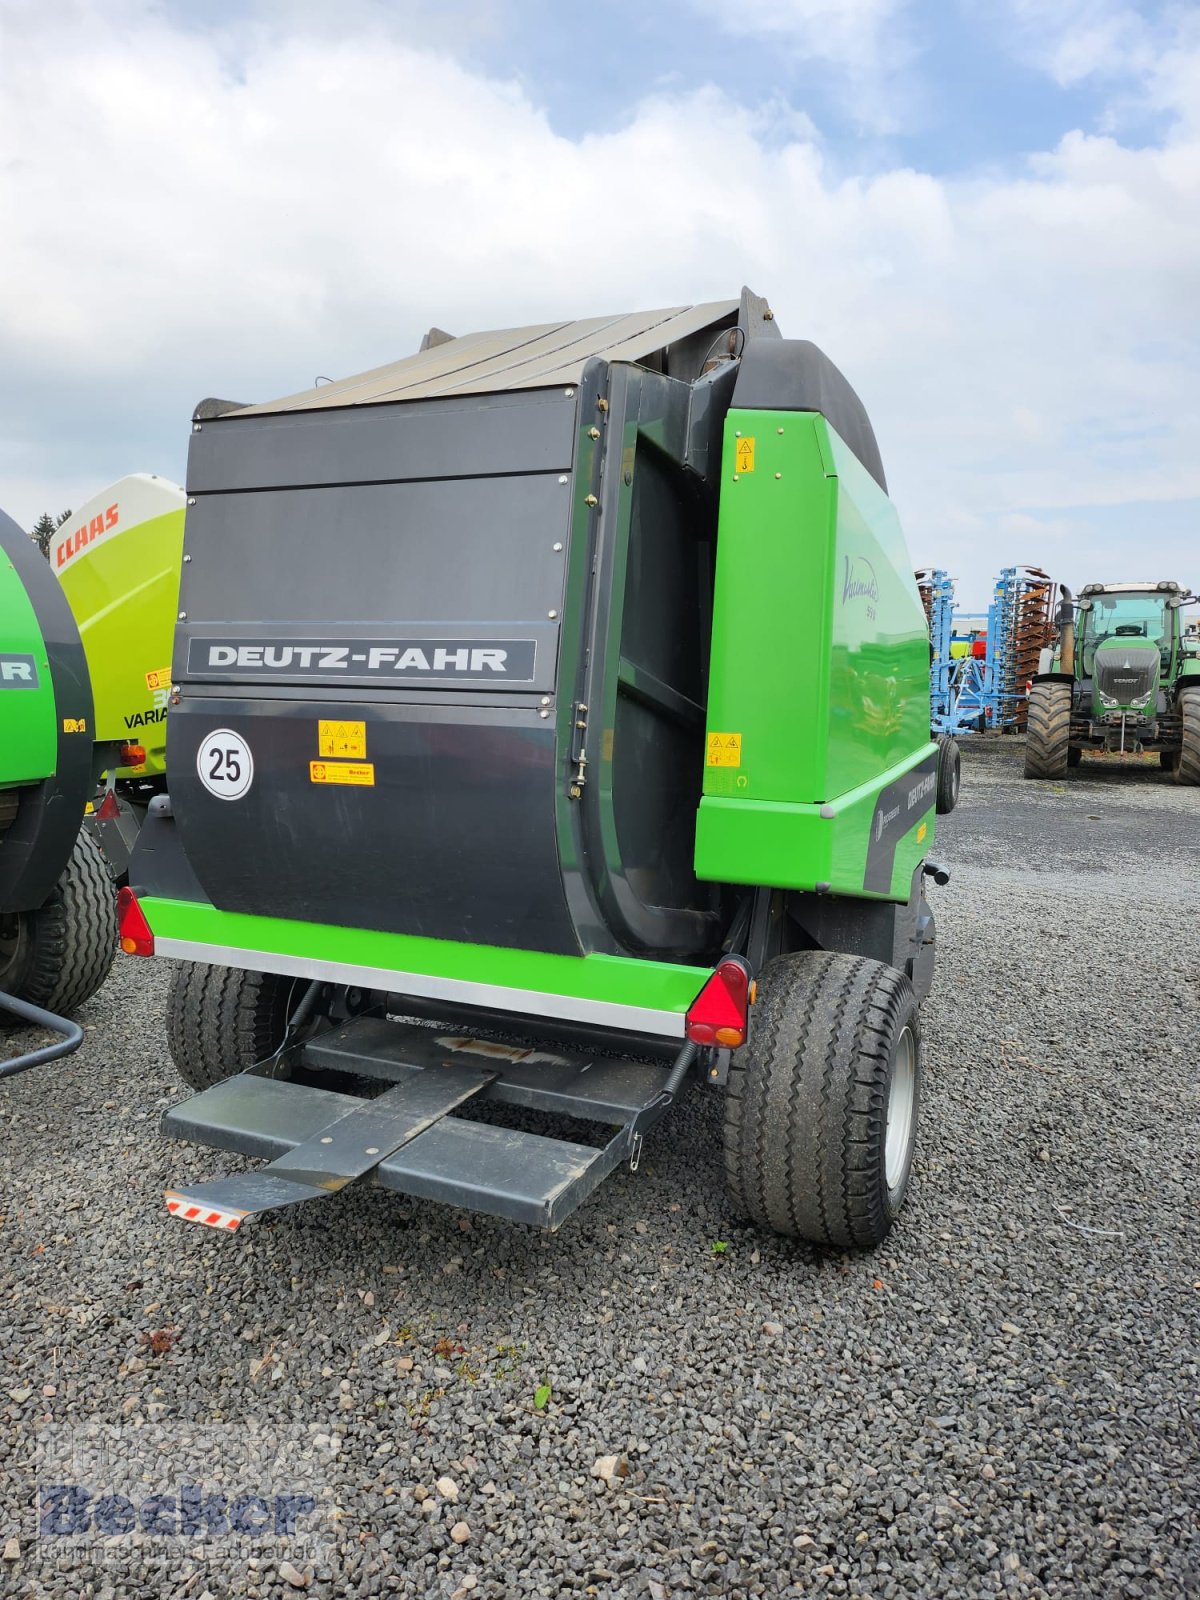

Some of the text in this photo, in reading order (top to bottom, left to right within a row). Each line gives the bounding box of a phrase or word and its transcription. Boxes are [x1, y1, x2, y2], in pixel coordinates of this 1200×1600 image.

[57, 503, 120, 568] CLAAS
[208, 646, 508, 672] DEUTZ-FAHR
[209, 747, 241, 782] 25
